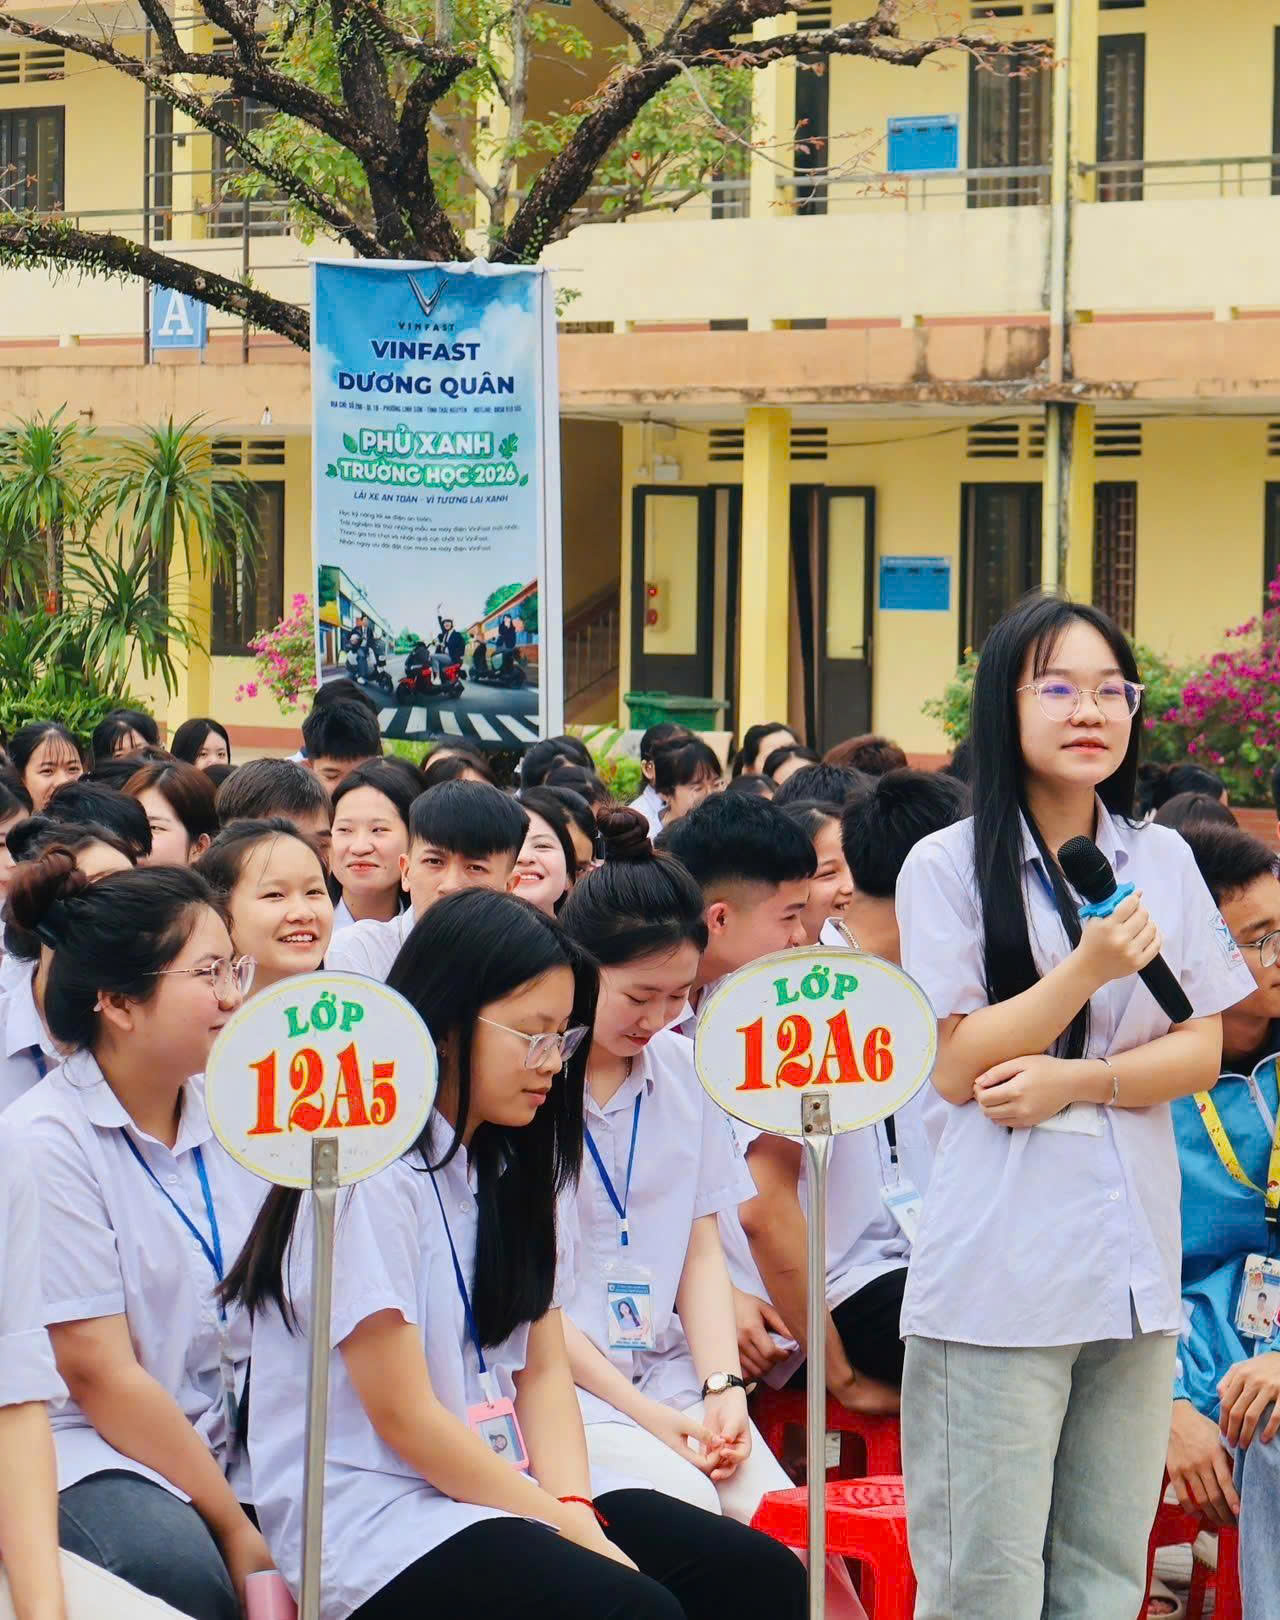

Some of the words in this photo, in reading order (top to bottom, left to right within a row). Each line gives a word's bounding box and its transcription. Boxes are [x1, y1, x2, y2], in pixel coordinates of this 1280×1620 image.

[158, 288, 194, 336] A
[398, 321, 456, 332] VINFAST
[371, 340, 480, 361] VINFAST
[338, 370, 432, 394] DƯƠNG
[440, 371, 514, 399] QUÂN
[360, 424, 412, 457] PHỦ
[416, 430, 493, 457] XANH
[339, 458, 421, 485] TRƯỜNG
[425, 464, 470, 490] HỌC
[472, 464, 518, 485] 2026
[368, 491, 380, 501] XE
[381, 493, 394, 502] AN
[485, 494, 509, 503] XANH
[773, 964, 859, 1006] LỚP
[284, 991, 364, 1038] LỚP
[735, 1008, 894, 1091] 12A6
[247, 1041, 397, 1136] 12A5
